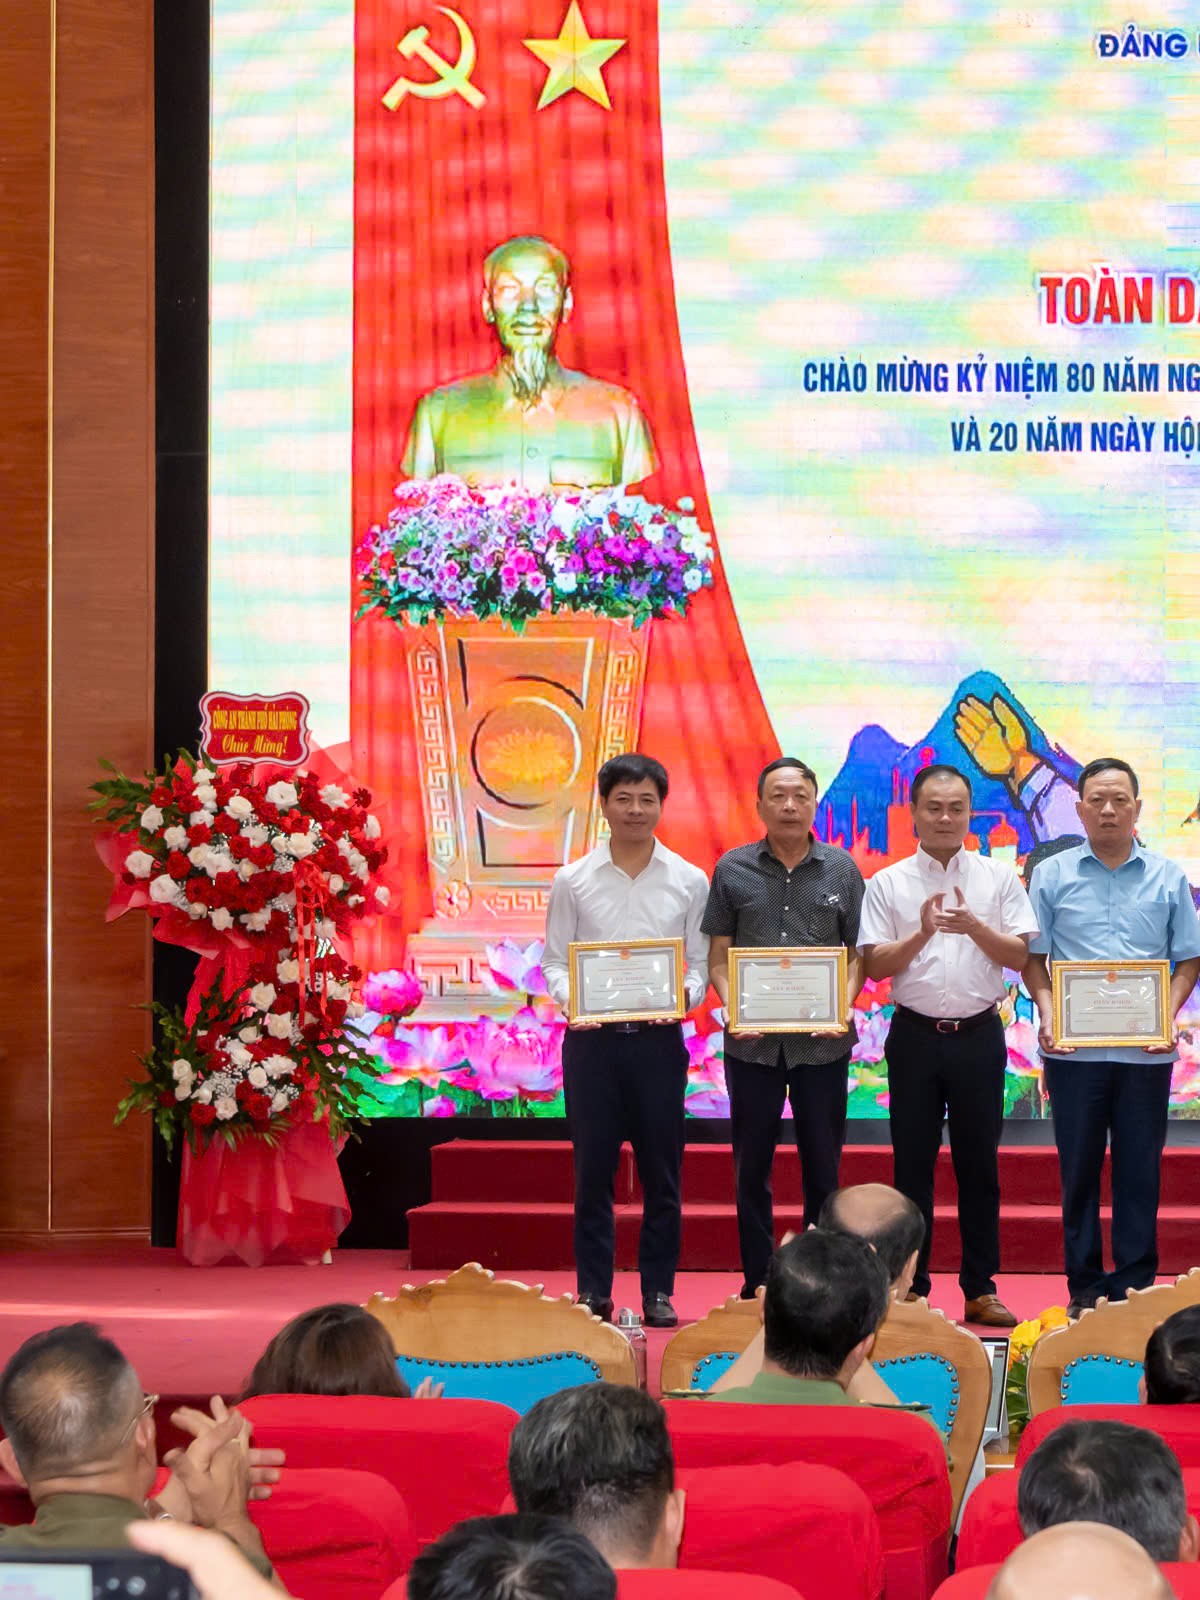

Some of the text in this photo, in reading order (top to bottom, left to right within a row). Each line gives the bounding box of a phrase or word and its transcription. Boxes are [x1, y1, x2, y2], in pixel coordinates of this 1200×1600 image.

[1098, 25, 1188, 57] ĐẢNG
[1040, 267, 1152, 324] TOÀN
[803, 356, 867, 393] CHÀO
[876, 355, 949, 393] MỪNG
[957, 353, 988, 393] KỶ
[995, 356, 1058, 400] NIỆM
[1066, 363, 1095, 393] 80
[1103, 356, 1159, 393] NĂM
[951, 415, 982, 451] VÀ
[989, 422, 1018, 451] 20
[1026, 415, 1083, 452] NĂM
[1091, 415, 1155, 452] NGÀY
